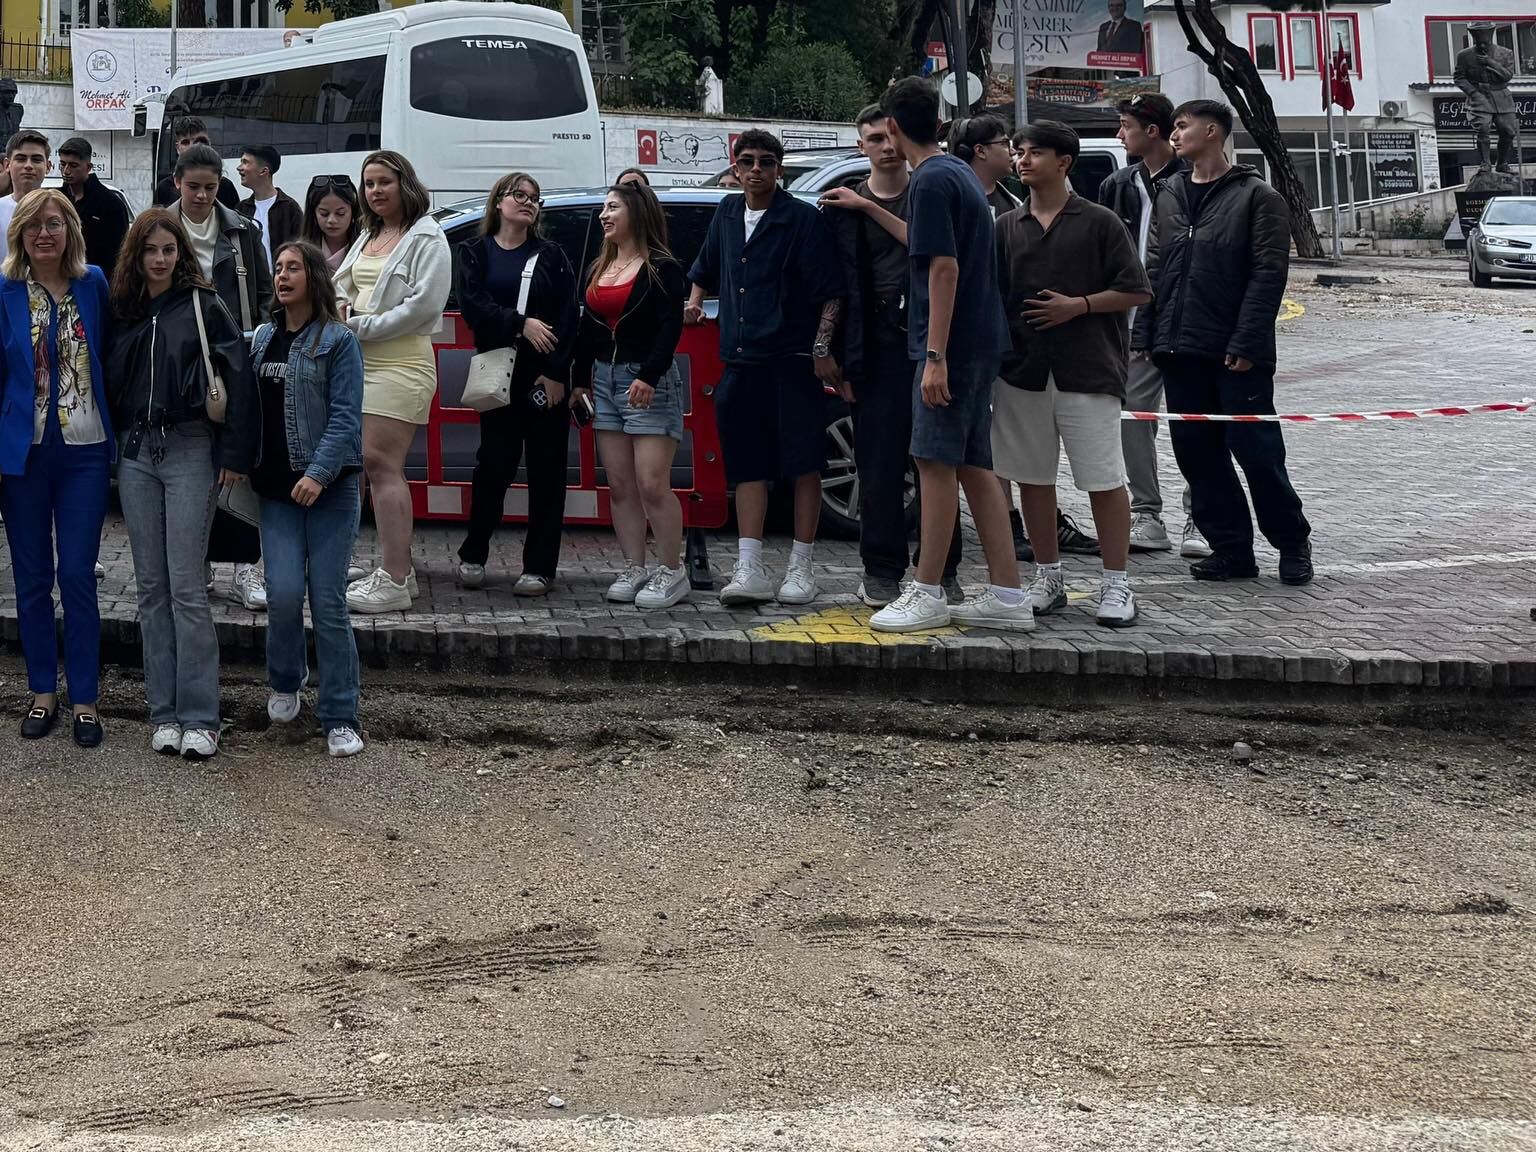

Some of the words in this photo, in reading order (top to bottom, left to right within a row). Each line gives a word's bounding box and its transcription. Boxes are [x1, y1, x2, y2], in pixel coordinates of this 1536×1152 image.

[461, 39, 528, 49] TEMSA
[997, 32, 1070, 54] OSUN
[79, 89, 114, 99] Mehmet
[116, 89, 131, 99] Ali
[86, 99, 126, 108] ORPAK
